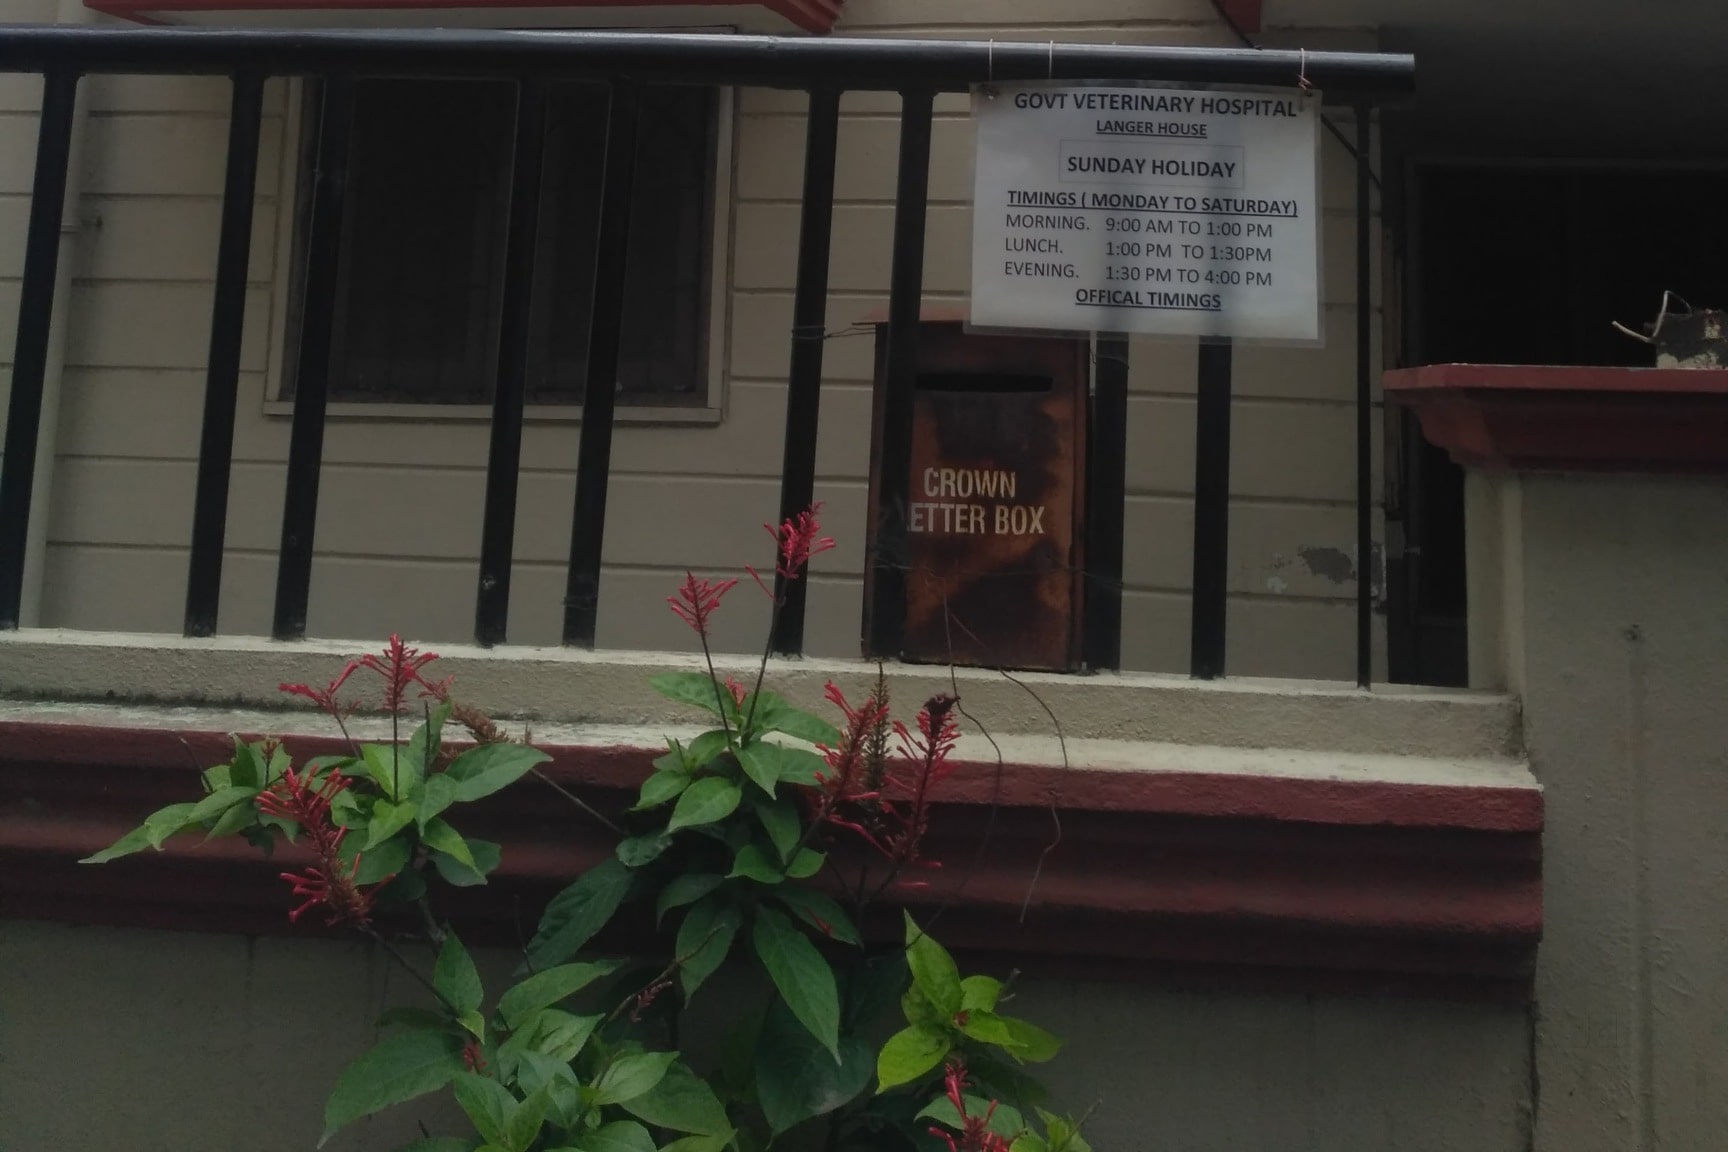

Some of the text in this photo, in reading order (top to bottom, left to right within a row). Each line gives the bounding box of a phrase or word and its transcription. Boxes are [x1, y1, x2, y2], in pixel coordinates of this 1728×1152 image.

[1014, 93, 1297, 118] GOVT VETERINARY HOSPITAL
[1096, 120, 1207, 137] LANGER HOUSE
[1067, 156, 1236, 178] SUNDAY HOLIDAY
[1007, 191, 1077, 206] TIMINGS
[1091, 193, 1169, 209] MONDAY
[1174, 197, 1197, 211] TO
[1202, 198, 1298, 216] SATURDAY)
[1006, 213, 1273, 238] MORNING. 9:00 AM TO 1:00 PM
[1005, 238, 1272, 262] LUNCH. 1:00 PM TO 1:30PM
[1005, 261, 1272, 286] EVENING. 1:30 PM TO 4:00 PM
[1076, 288, 1222, 309] OFFICAL TIMINGS
[923, 466, 1016, 498] CROWN
[907, 502, 1045, 535] ETTER BOX
